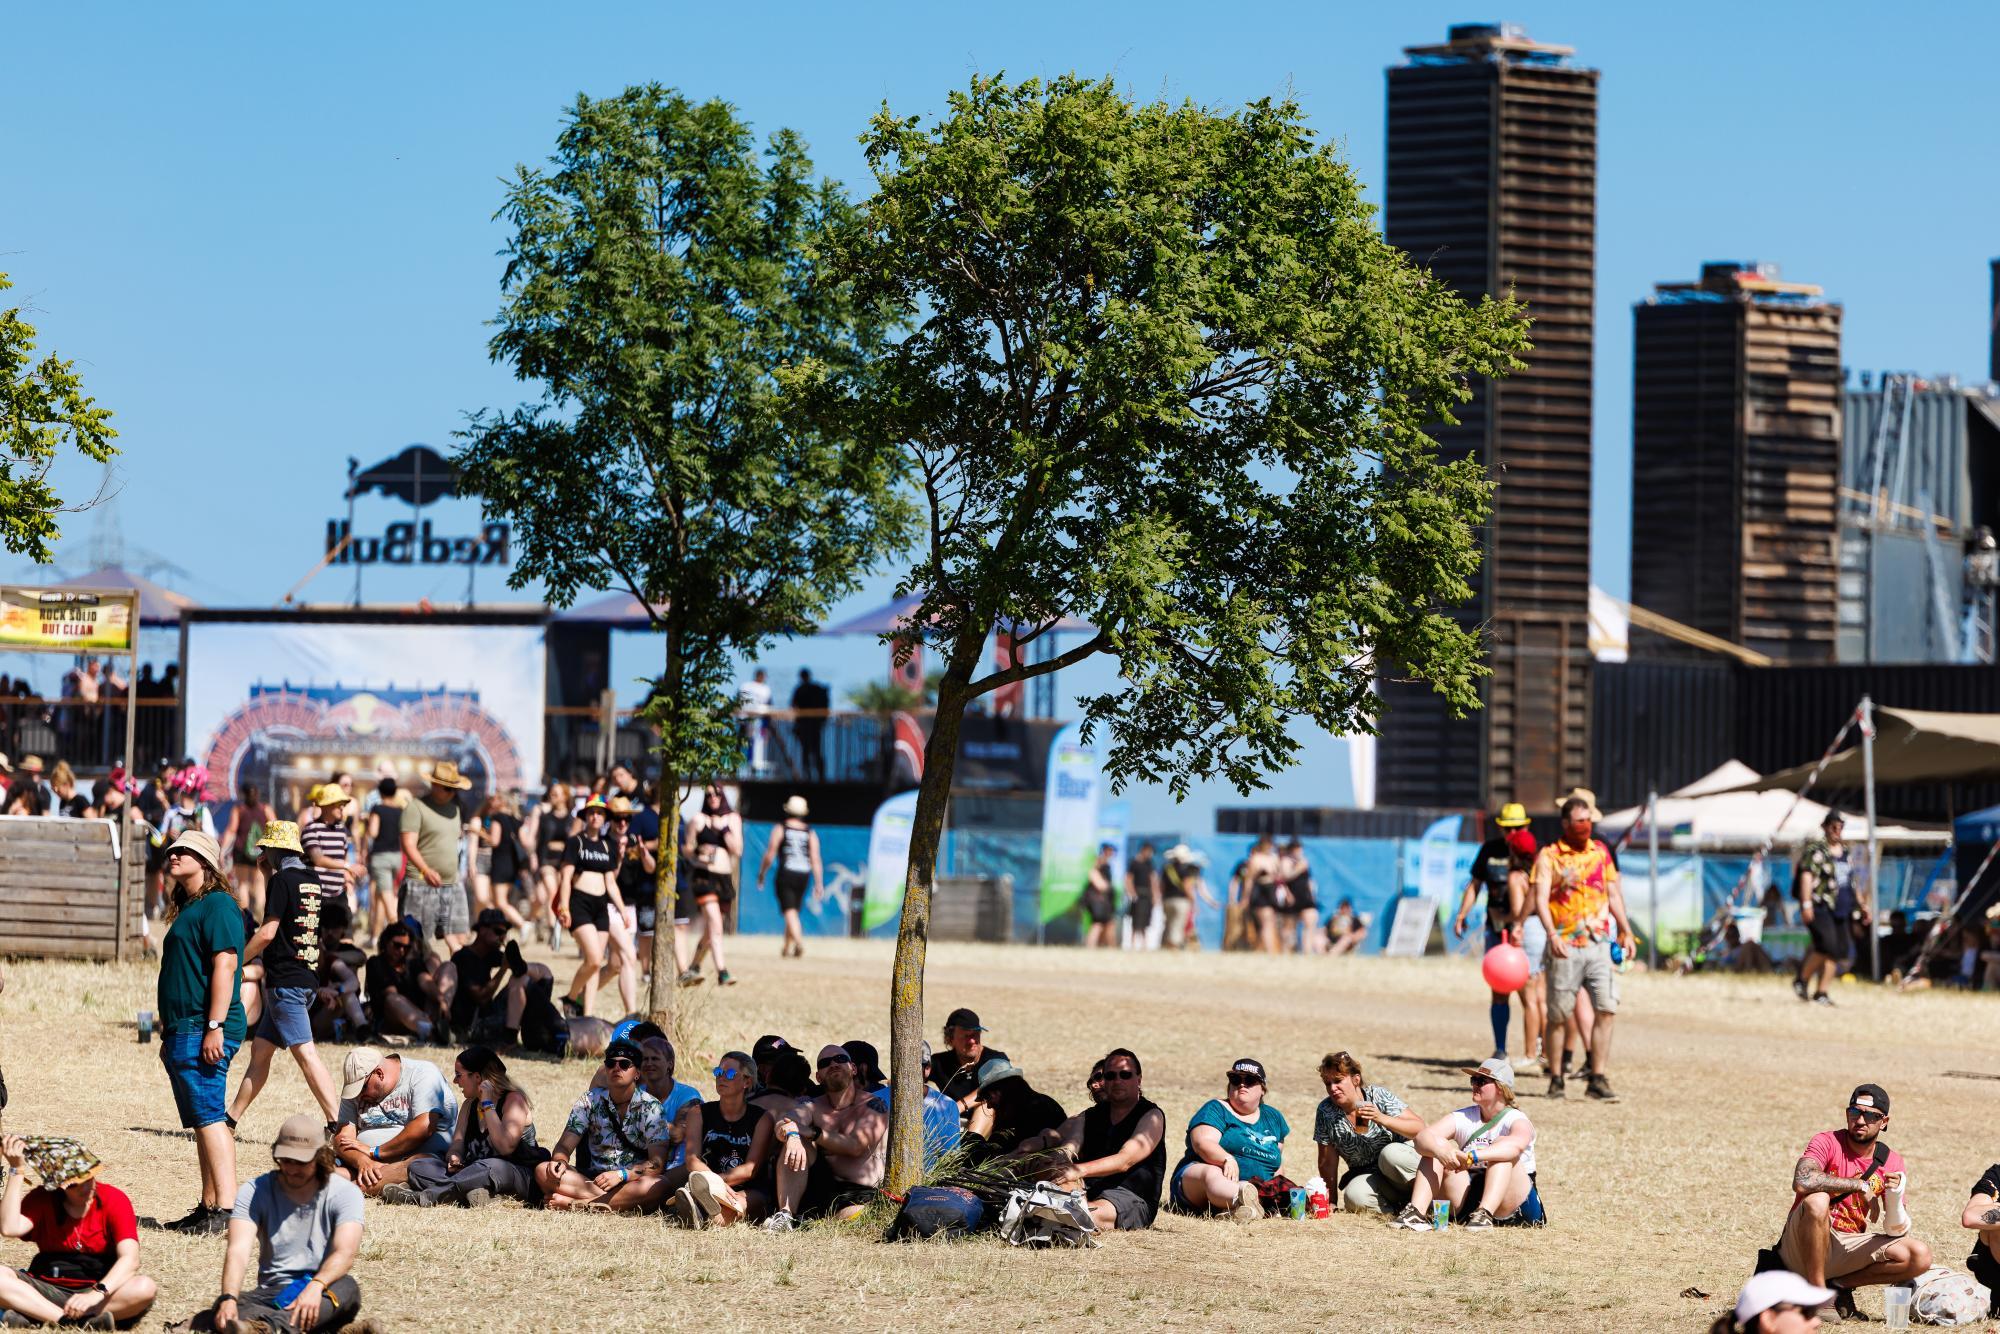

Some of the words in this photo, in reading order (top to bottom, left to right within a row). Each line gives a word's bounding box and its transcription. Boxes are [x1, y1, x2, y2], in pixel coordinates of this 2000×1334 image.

[39, 607, 66, 621] ROCK
[69, 608, 97, 622] SOLID
[42, 623, 60, 636] BUT
[63, 623, 94, 636] CLEAN
